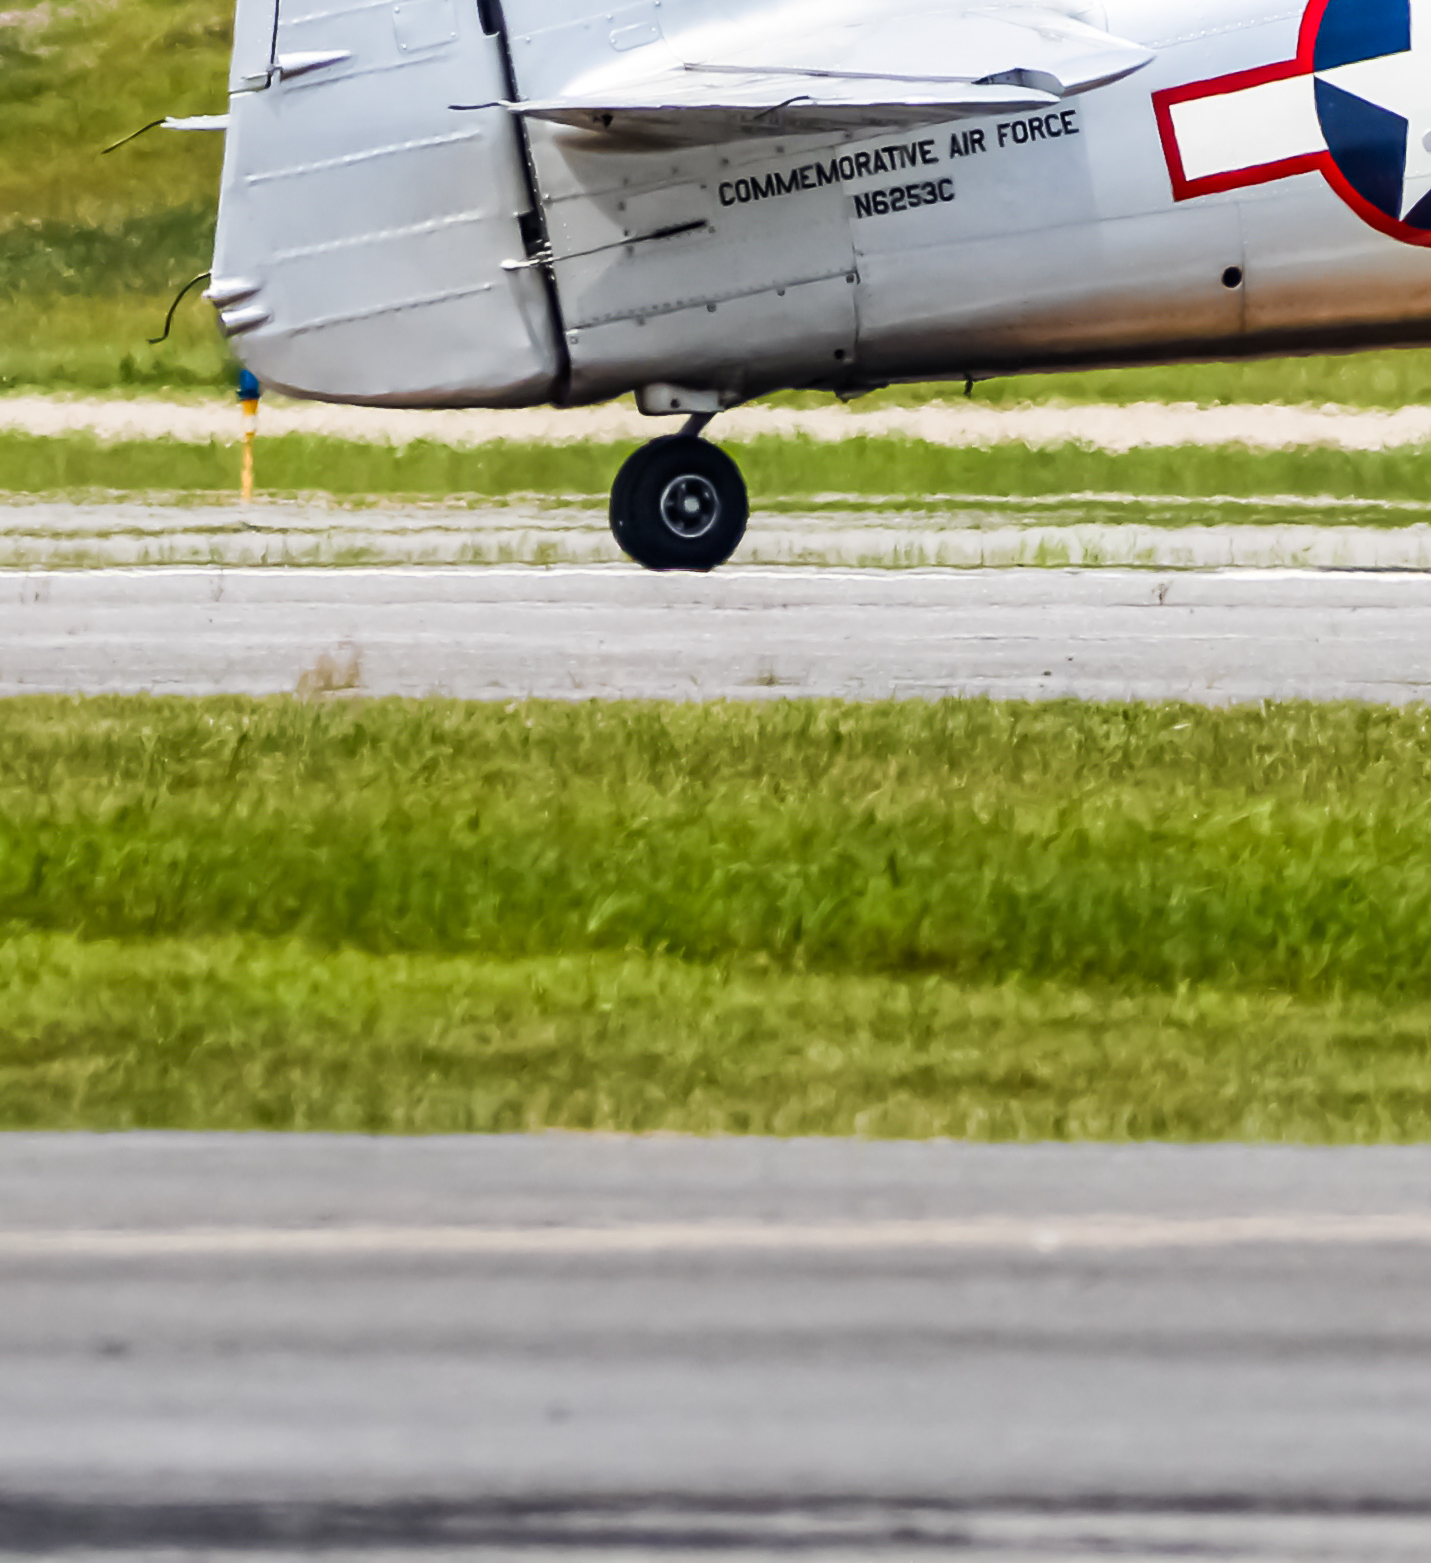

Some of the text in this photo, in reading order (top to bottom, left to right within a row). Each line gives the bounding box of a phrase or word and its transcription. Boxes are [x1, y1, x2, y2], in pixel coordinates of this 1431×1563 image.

[718, 109, 1080, 207] COMMEMORATIVE AIR FORCE
[853, 178, 956, 219] N6253C
